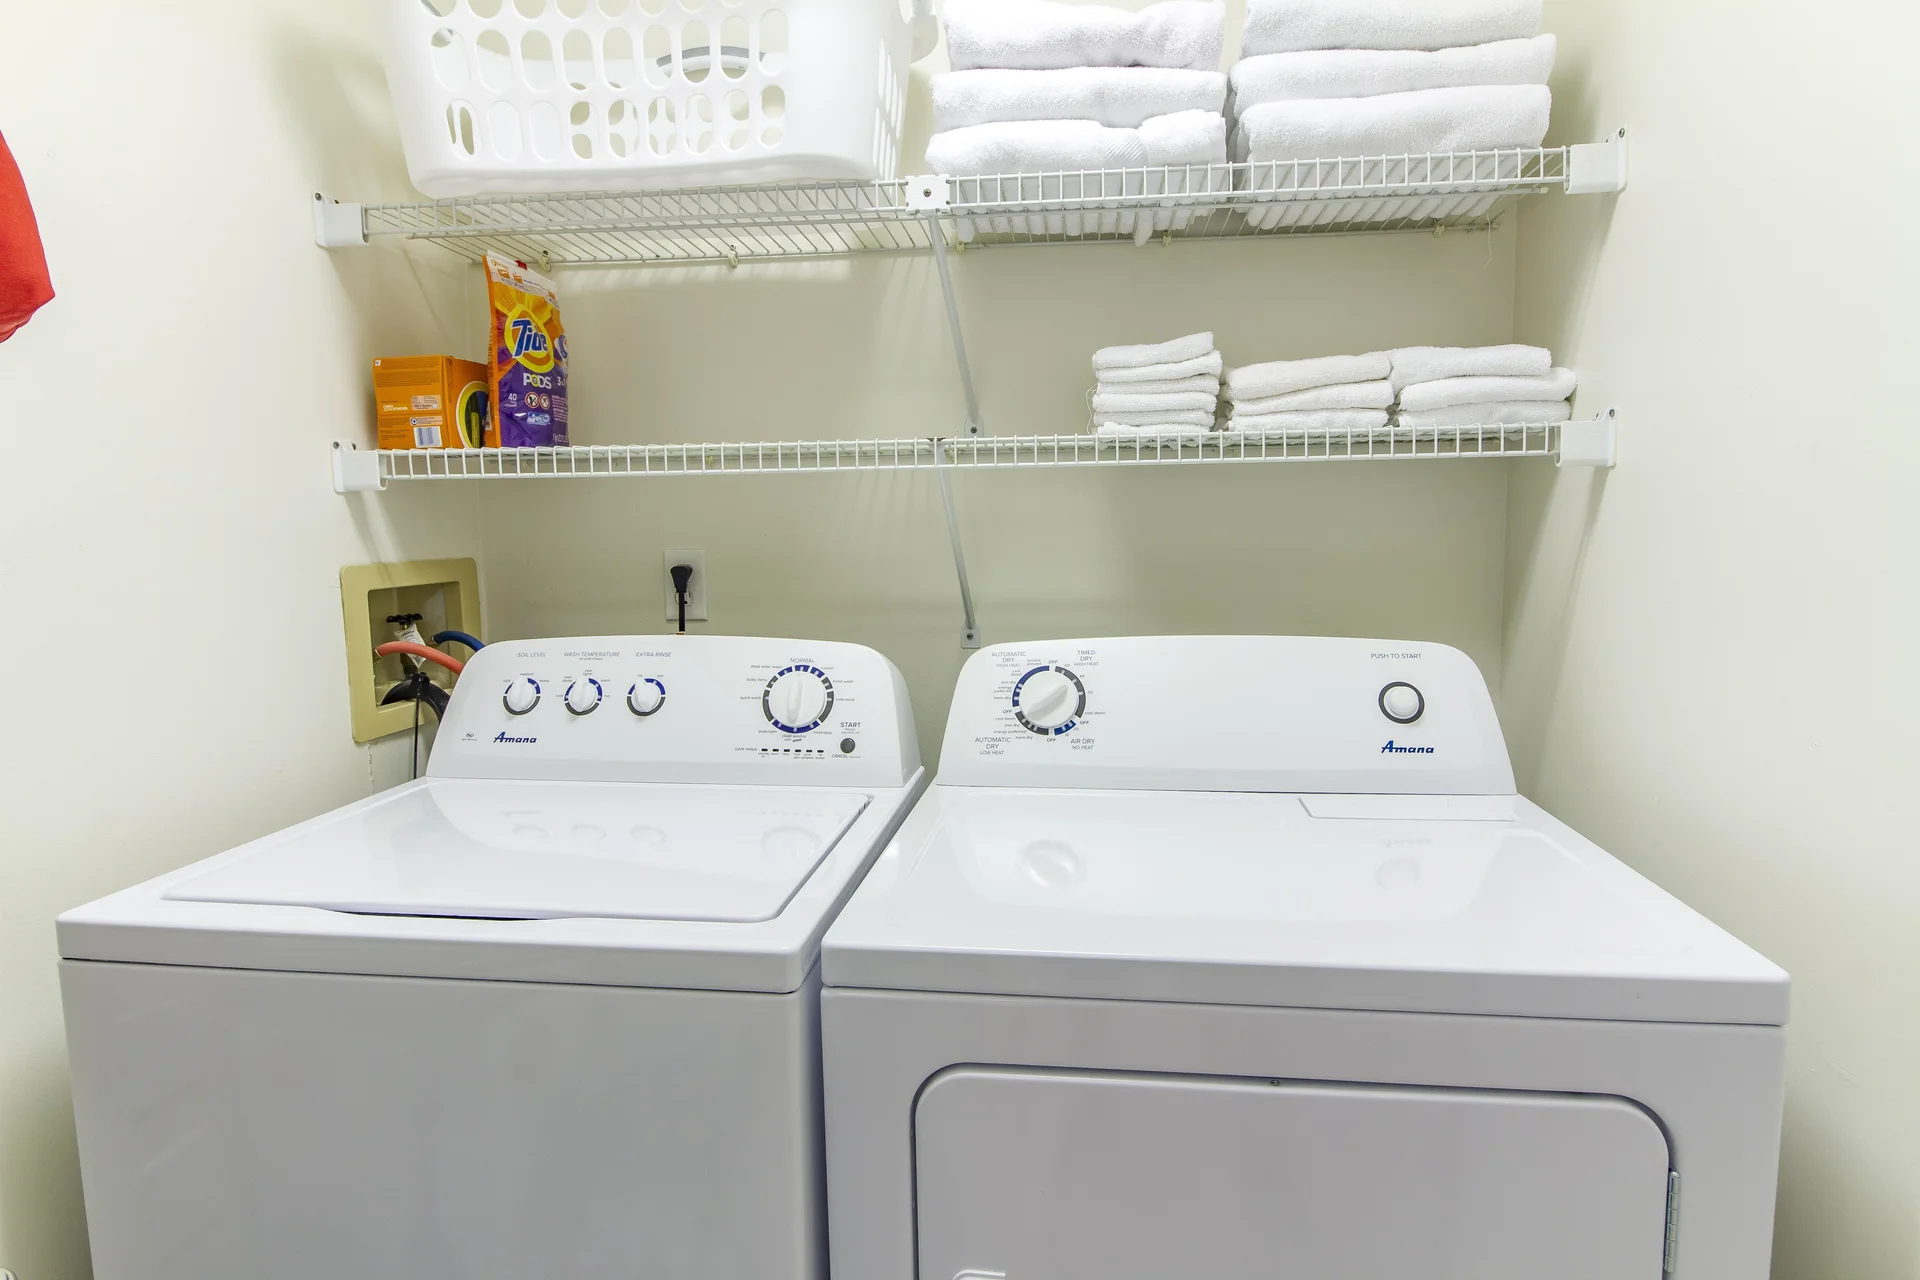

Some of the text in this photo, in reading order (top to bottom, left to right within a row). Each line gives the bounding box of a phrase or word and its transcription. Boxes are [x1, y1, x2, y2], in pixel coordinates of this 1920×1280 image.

[511, 318, 548, 358] Tide
[523, 372, 552, 390] PODS
[508, 392, 518, 401] 40
[493, 731, 537, 744] Amana
[1381, 740, 1434, 754] Amana
